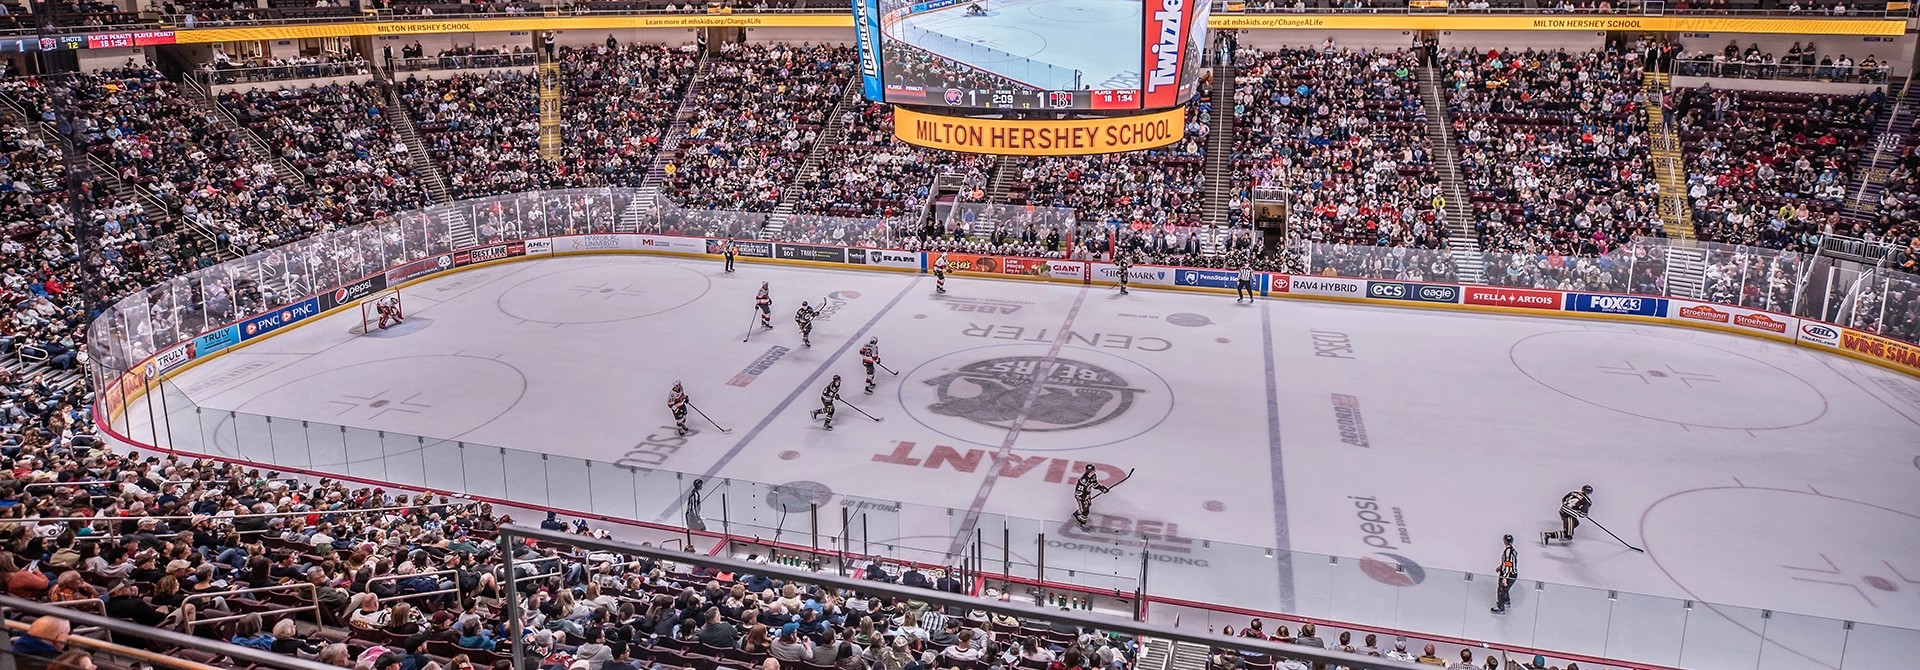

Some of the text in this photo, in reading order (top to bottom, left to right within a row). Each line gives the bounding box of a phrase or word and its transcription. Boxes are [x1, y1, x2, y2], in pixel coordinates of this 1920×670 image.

[688, 18, 762, 26] mhskids.org/ChangeALife
[1232, 18, 1324, 27] mhskids.org/ChangeALife
[16, 40, 24, 52] 1
[864, 52, 876, 76] ICE
[969, 90, 976, 106] 1
[992, 95, 1013, 104] 2:09
[1037, 92, 1044, 108] 1
[916, 118, 1171, 148] MILTON HERSHEY SCHOOL
[472, 249, 490, 258] BEST
[491, 246, 506, 255] LINE
[389, 260, 438, 280] PLATINUM
[349, 280, 372, 296] pepsi
[1293, 281, 1357, 292] RAV4 HYBRID
[1373, 286, 1402, 296] ecs
[1424, 288, 1451, 299] eagle
[1473, 293, 1552, 304] STELLA ARTOIS
[1591, 296, 1642, 310] FOX43
[292, 303, 313, 318] PNC
[945, 303, 1022, 315] ABEL
[1683, 308, 1726, 319] Stroehmann
[258, 316, 280, 330] PNC
[1737, 316, 1783, 329] Stroehmann
[203, 328, 230, 343] TRULY
[962, 322, 1173, 352] CENTER
[1809, 327, 1831, 337] AHL
[1844, 334, 1884, 357] WING
[157, 348, 184, 366] TRULY
[748, 345, 791, 376] ACCORD
[991, 360, 1100, 381] BEARS
[1334, 406, 1362, 445] ACCORD
[871, 440, 1127, 486] GIANT
[1347, 495, 1398, 550] pepsi
[1392, 506, 1411, 544] ZERO SUGAR
